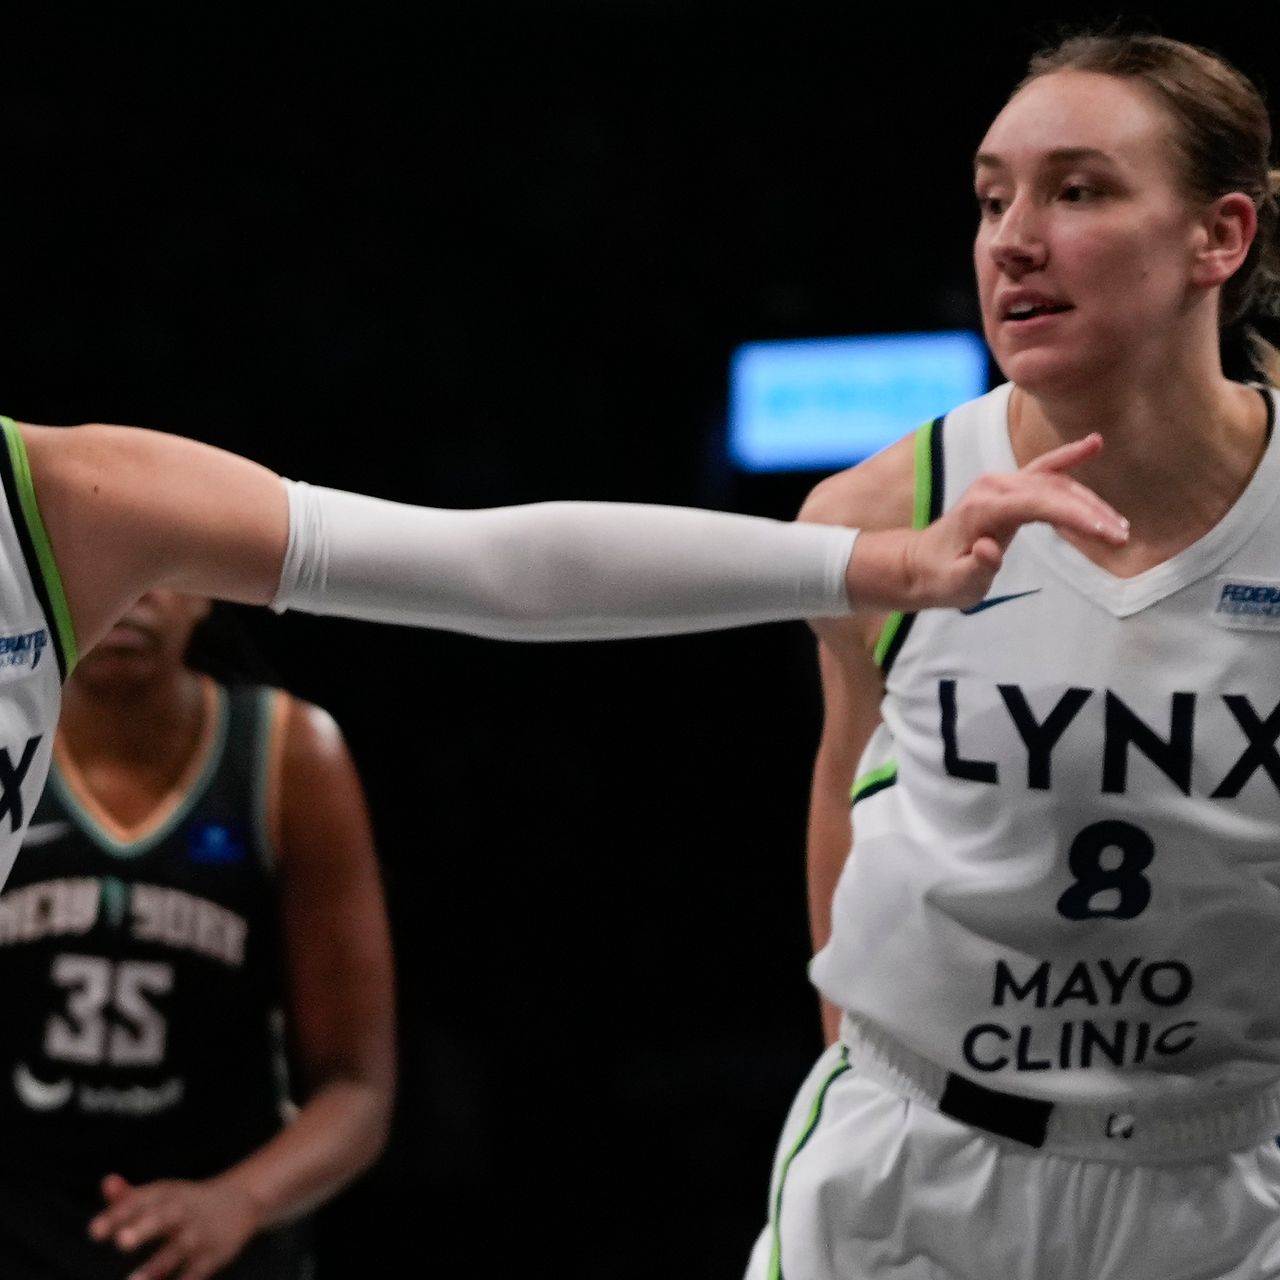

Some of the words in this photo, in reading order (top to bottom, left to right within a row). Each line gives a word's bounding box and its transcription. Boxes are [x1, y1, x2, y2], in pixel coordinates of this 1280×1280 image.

[939, 679, 1280, 799] LYNX
[1056, 820, 1154, 921] 8
[45, 953, 173, 1065] 35
[992, 957, 1193, 1009] MAYO
[963, 1019, 1199, 1073] CLINIC
